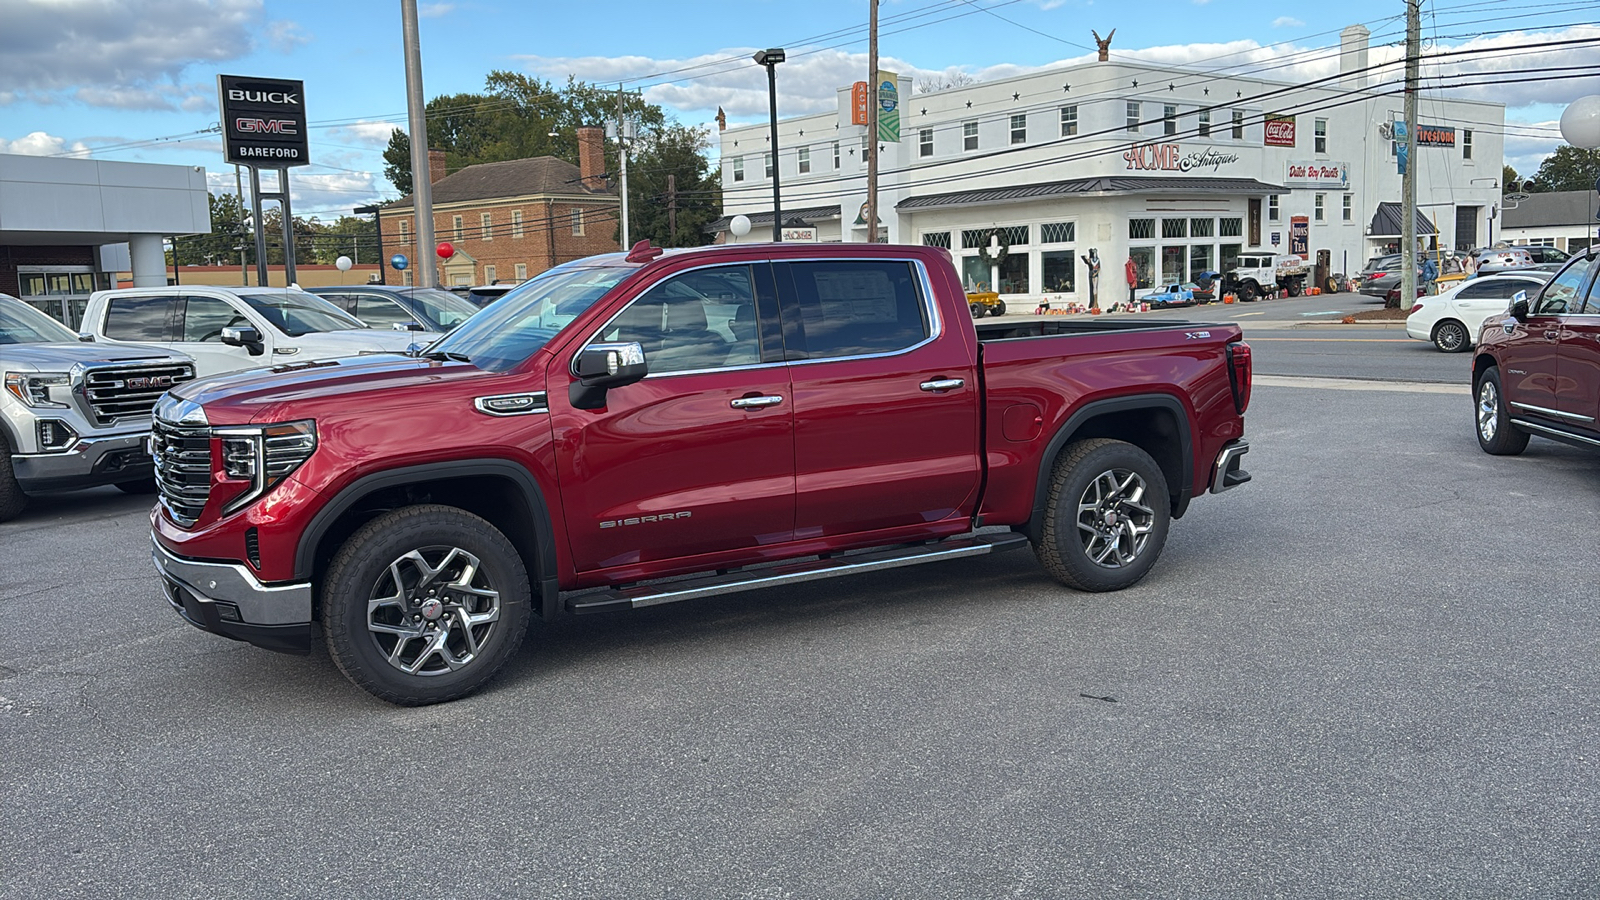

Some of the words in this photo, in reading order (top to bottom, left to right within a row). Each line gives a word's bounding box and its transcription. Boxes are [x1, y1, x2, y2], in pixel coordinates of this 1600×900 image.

[228, 89, 299, 105] BUICK
[236, 117, 298, 135] GMC
[240, 146, 299, 158] BAREFORD
[1123, 143, 1180, 171] ACME
[1180, 146, 1239, 173] Antiques
[1289, 165, 1306, 178] Dutch
[1307, 165, 1320, 180] Boy
[1320, 166, 1339, 178] Paints
[1294, 241, 1306, 252] TEA
[127, 375, 171, 389] GMC
[600, 511, 691, 529] SIERRA
